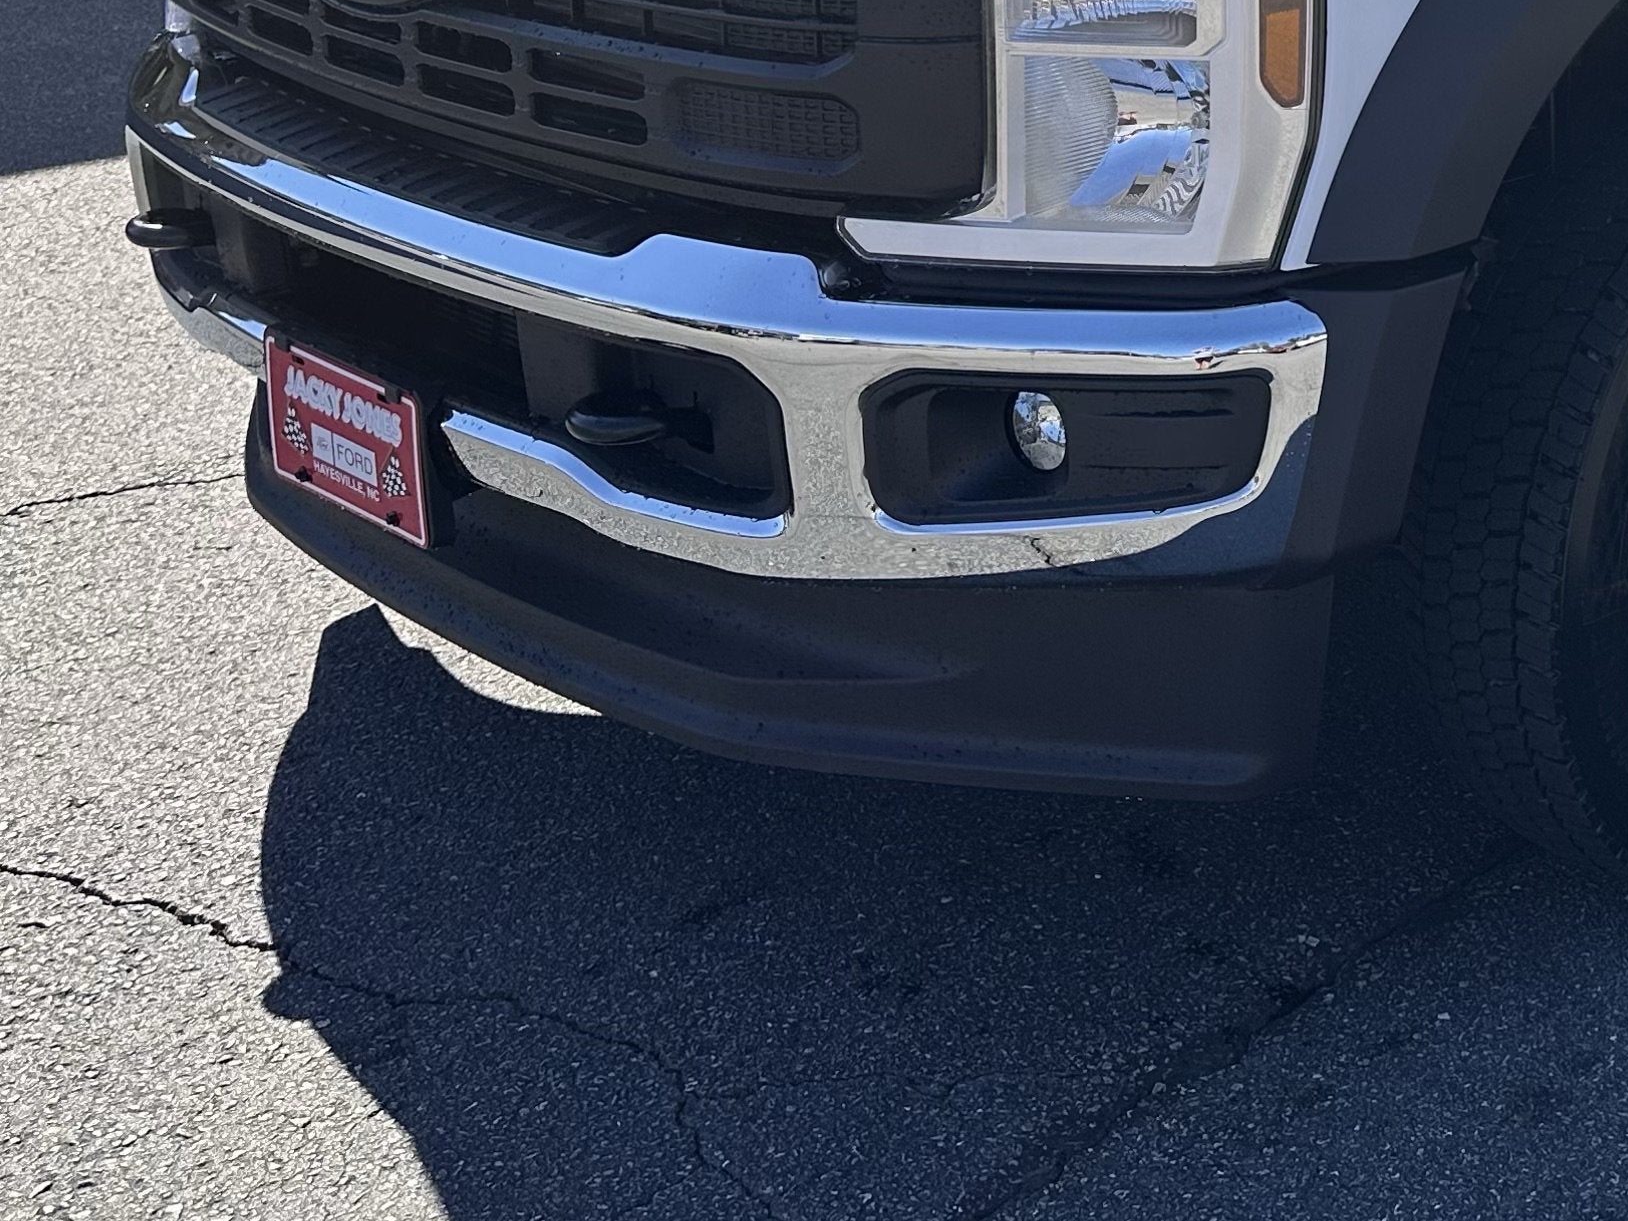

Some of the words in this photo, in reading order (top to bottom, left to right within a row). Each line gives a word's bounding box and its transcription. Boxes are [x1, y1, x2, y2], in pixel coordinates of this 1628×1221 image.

[284, 364, 343, 420] JACKY
[341, 392, 402, 448] JONES
[336, 443, 373, 476] FORD
[366, 485, 380, 502] NC
